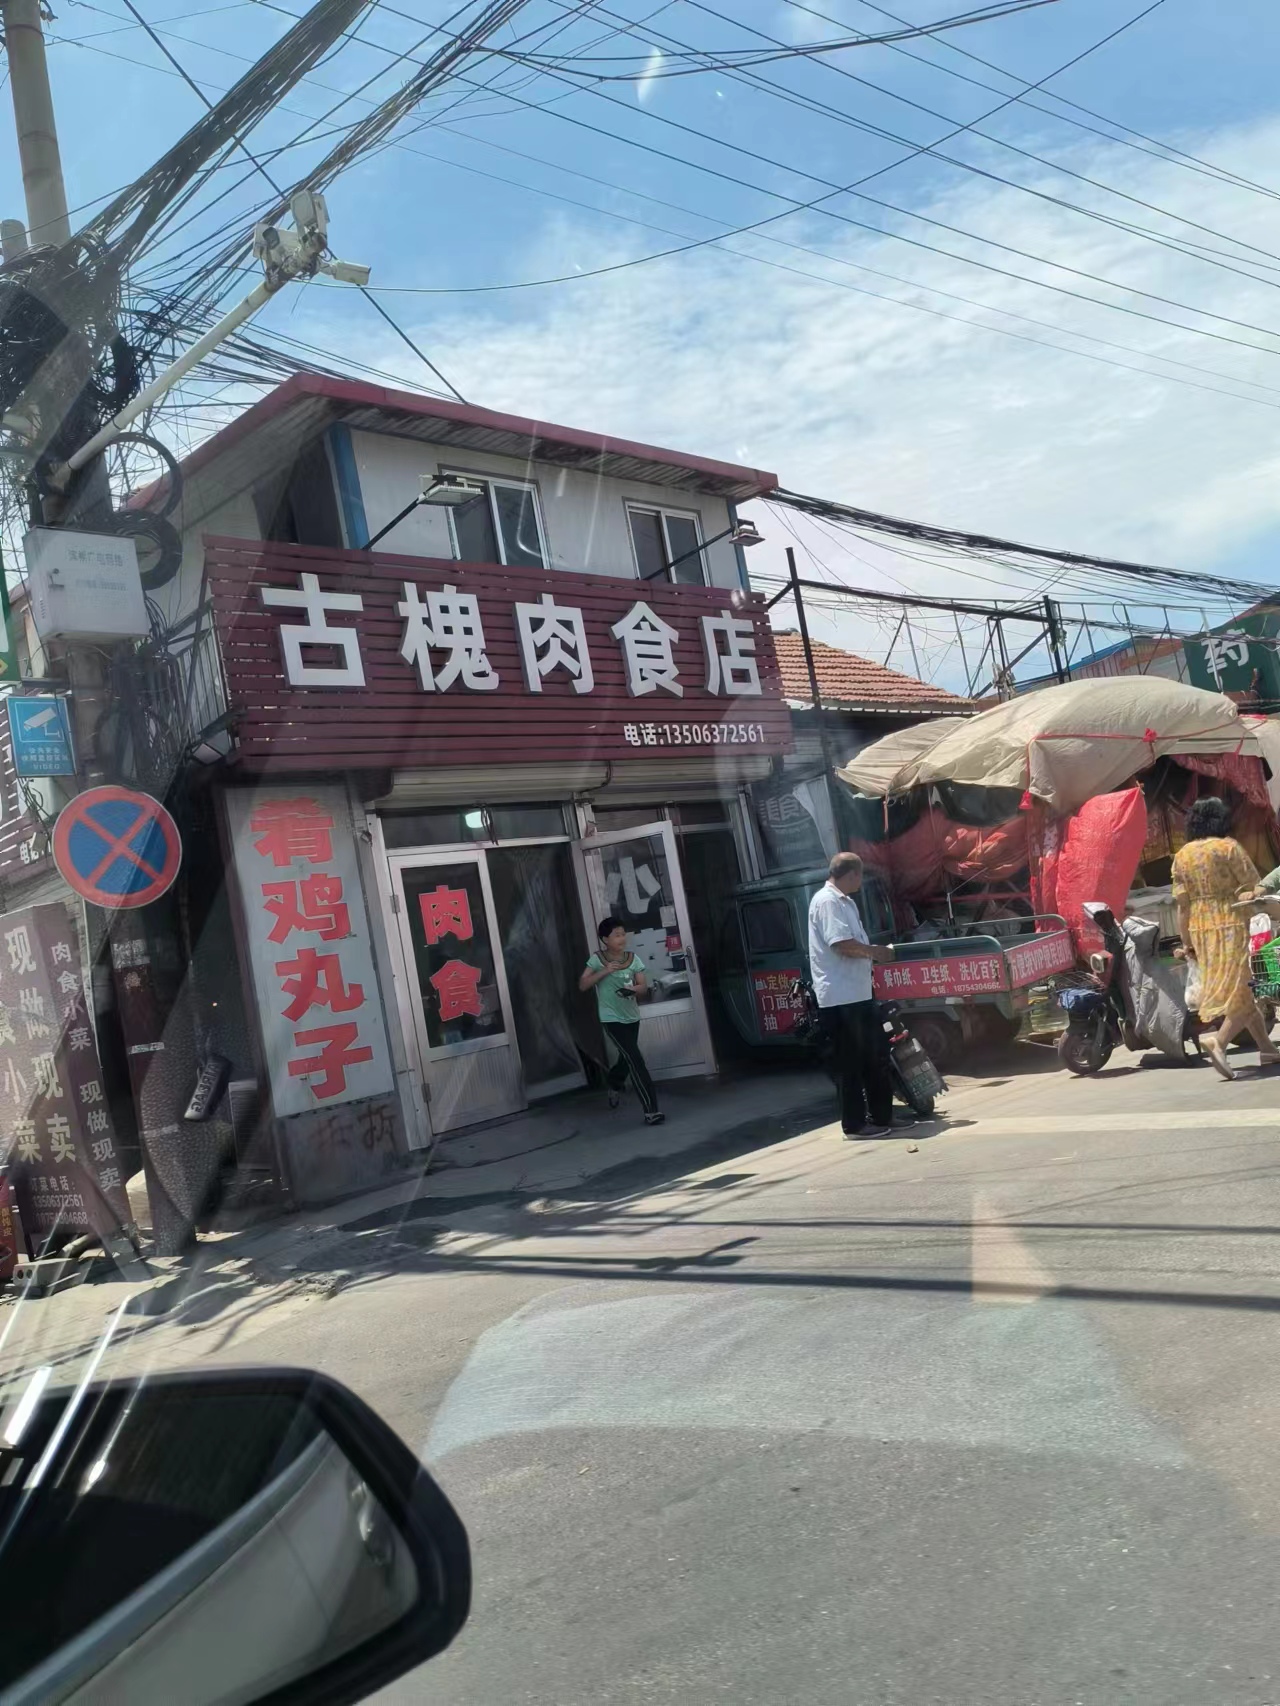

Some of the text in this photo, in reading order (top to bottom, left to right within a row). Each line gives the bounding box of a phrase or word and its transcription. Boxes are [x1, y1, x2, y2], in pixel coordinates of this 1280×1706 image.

[261, 572, 763, 699] 古槐肉食店
[624, 723, 765, 746] 电话:13506372561
[418, 885, 484, 1022] 肉食
[80, 1080, 121, 1192] 现做现卖
